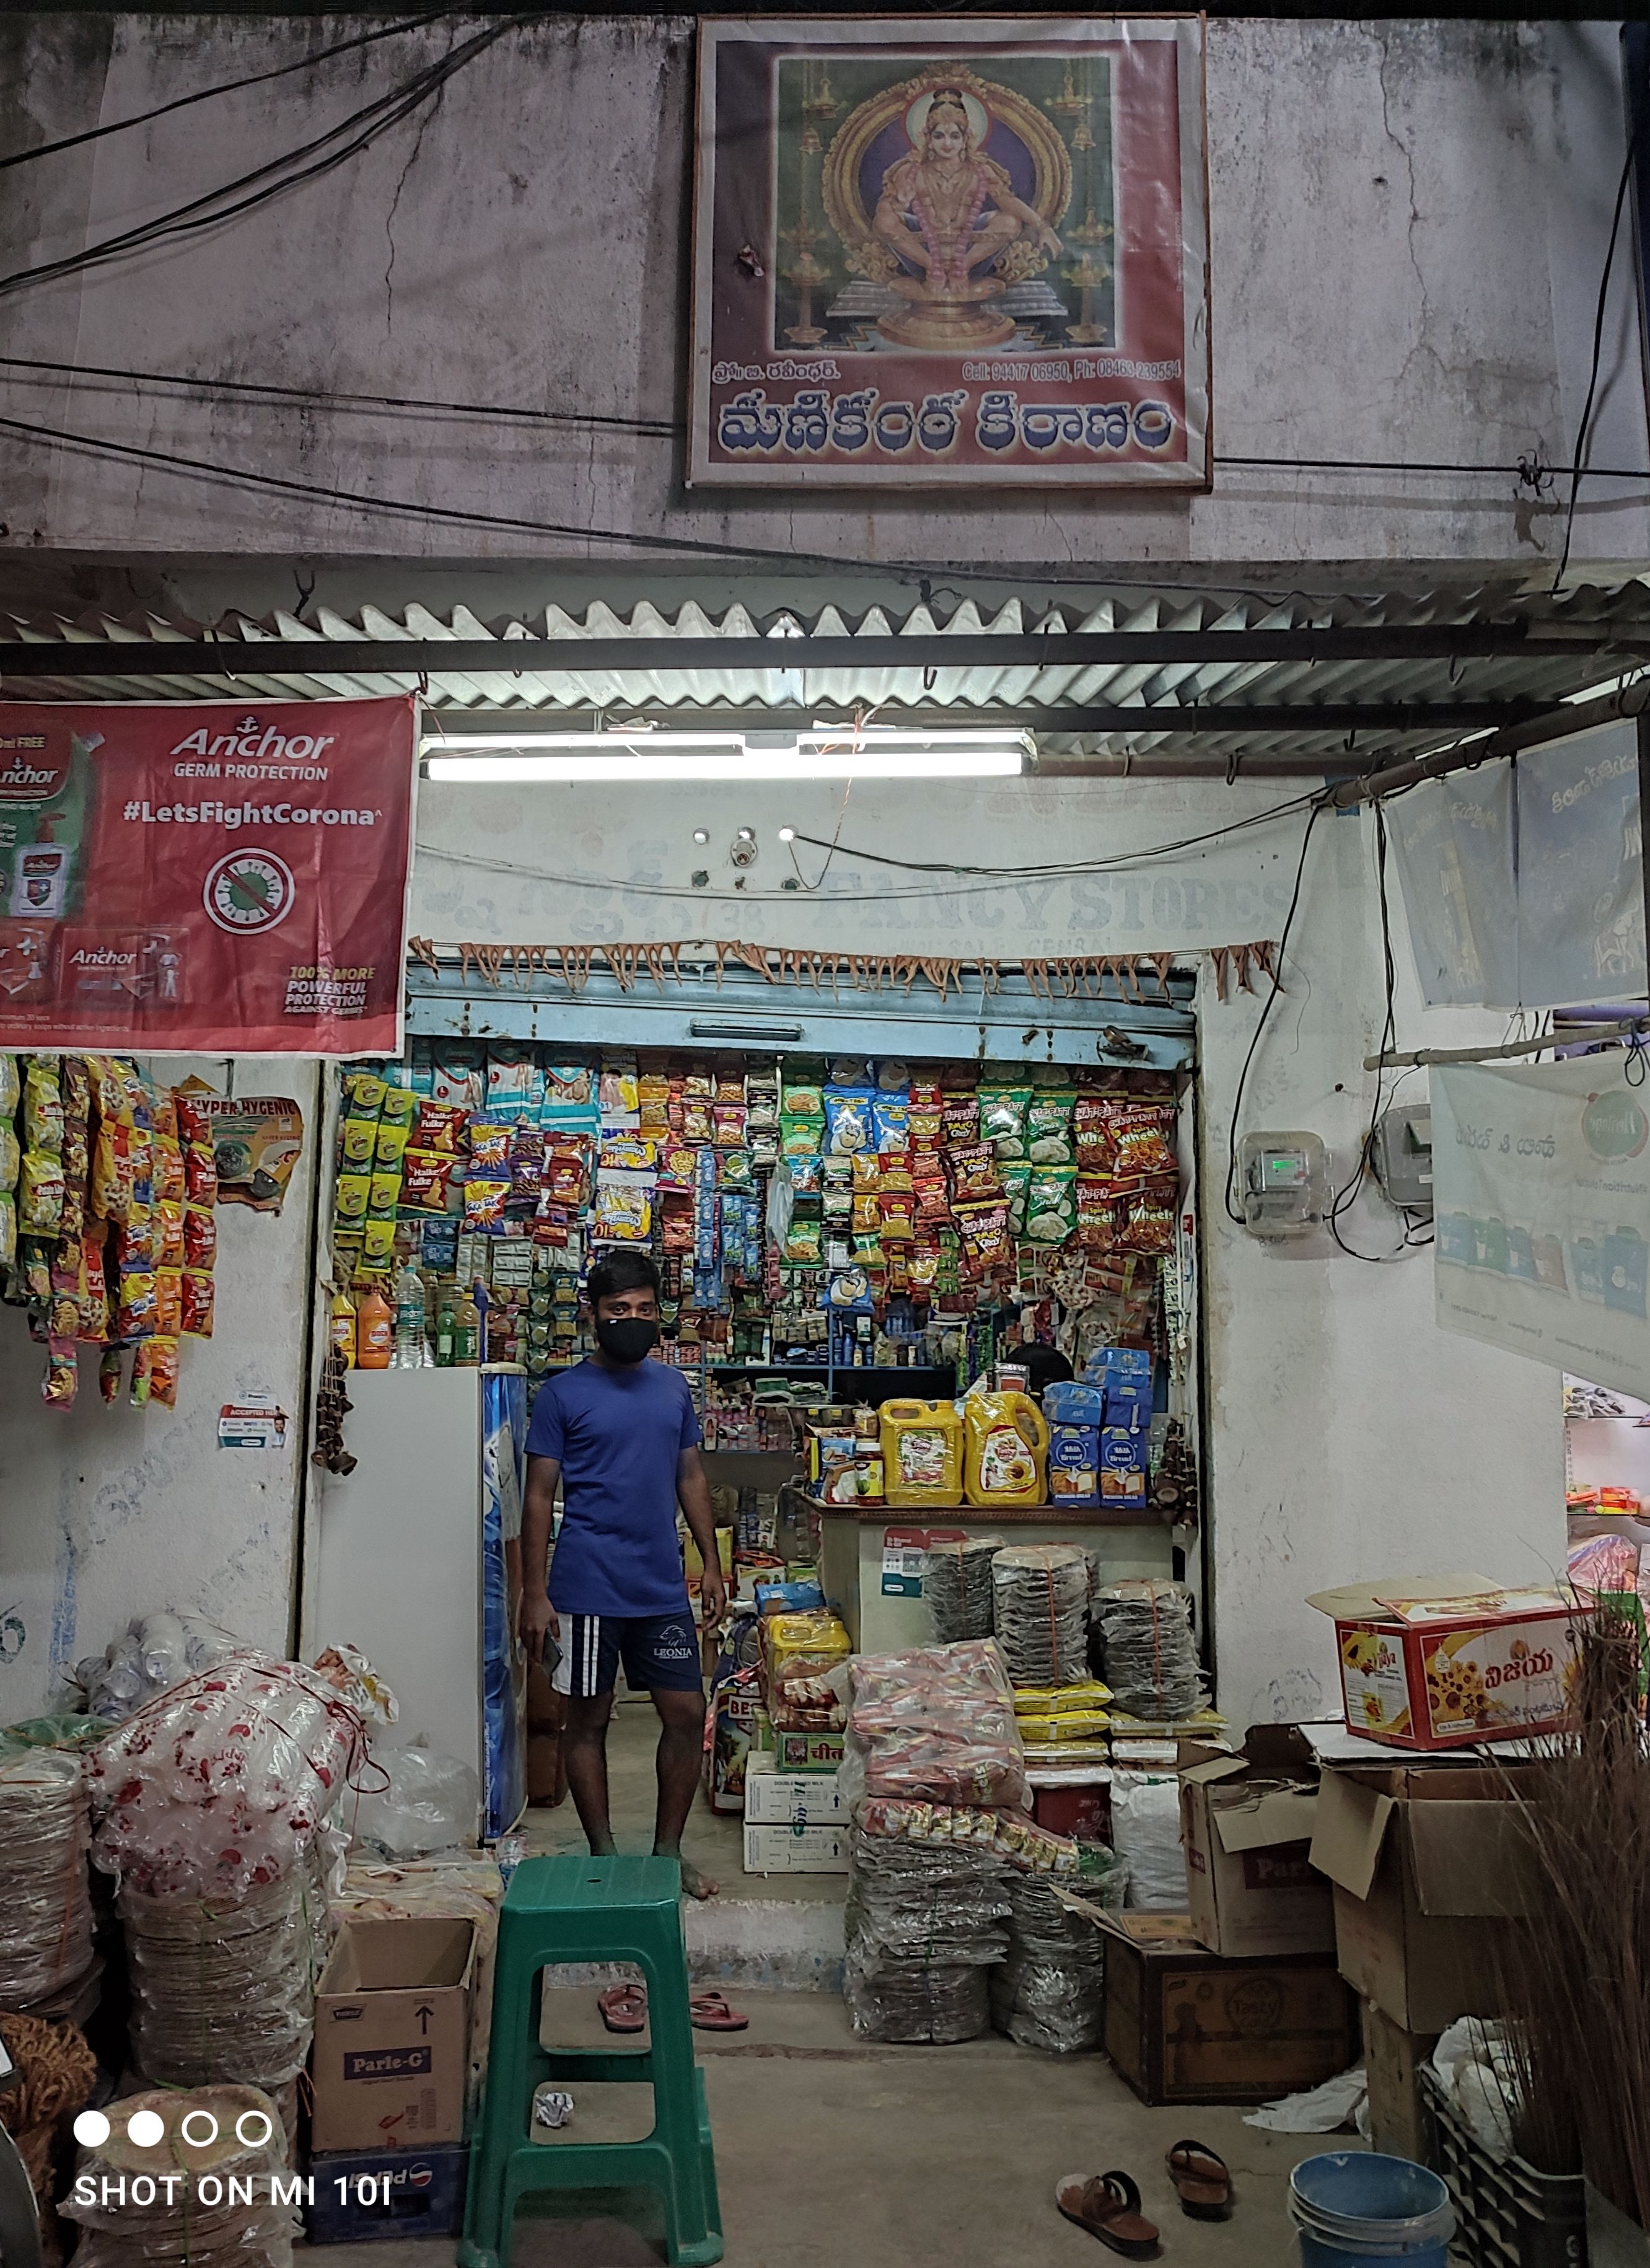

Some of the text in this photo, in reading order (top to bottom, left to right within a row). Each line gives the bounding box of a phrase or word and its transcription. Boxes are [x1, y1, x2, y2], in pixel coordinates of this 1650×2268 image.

[962, 361, 990, 381] Cell:
[991, 363, 1029, 381] 94417
[1074, 359, 1096, 379] Ph:
[17, 737, 45, 748] FREE
[170, 726, 335, 760] Anchor
[0, 765, 58, 784] nchor
[174, 763, 328, 781] GERM PROTECTION
[813, 872, 1294, 931] FANCY STORES
[68, 949, 137, 964] Anchor
[290, 966, 376, 980] 100% MORE
[287, 980, 367, 995] POWERFUL
[285, 993, 366, 1007] PROTECTION
[241, 1101, 296, 1115] HYGENIC
[421, 1120, 445, 1128] Fulke
[1076, 1132, 1106, 1146] Whe
[1117, 1127, 1159, 1146] Wheel
[408, 1177, 432, 1186] Fulke
[1076, 1210, 1115, 1226] Wheel
[1128, 1208, 1175, 1223] Wheels
[654, 1647, 693, 1656] LEONIA
[1485, 1648, 1554, 1690] విజయ
[810, 1742, 845, 1760] चीत
[975, 1765, 993, 1804] heels
[1257, 1857, 1310, 1880] Par
[353, 2052, 424, 2073] Parle-G
